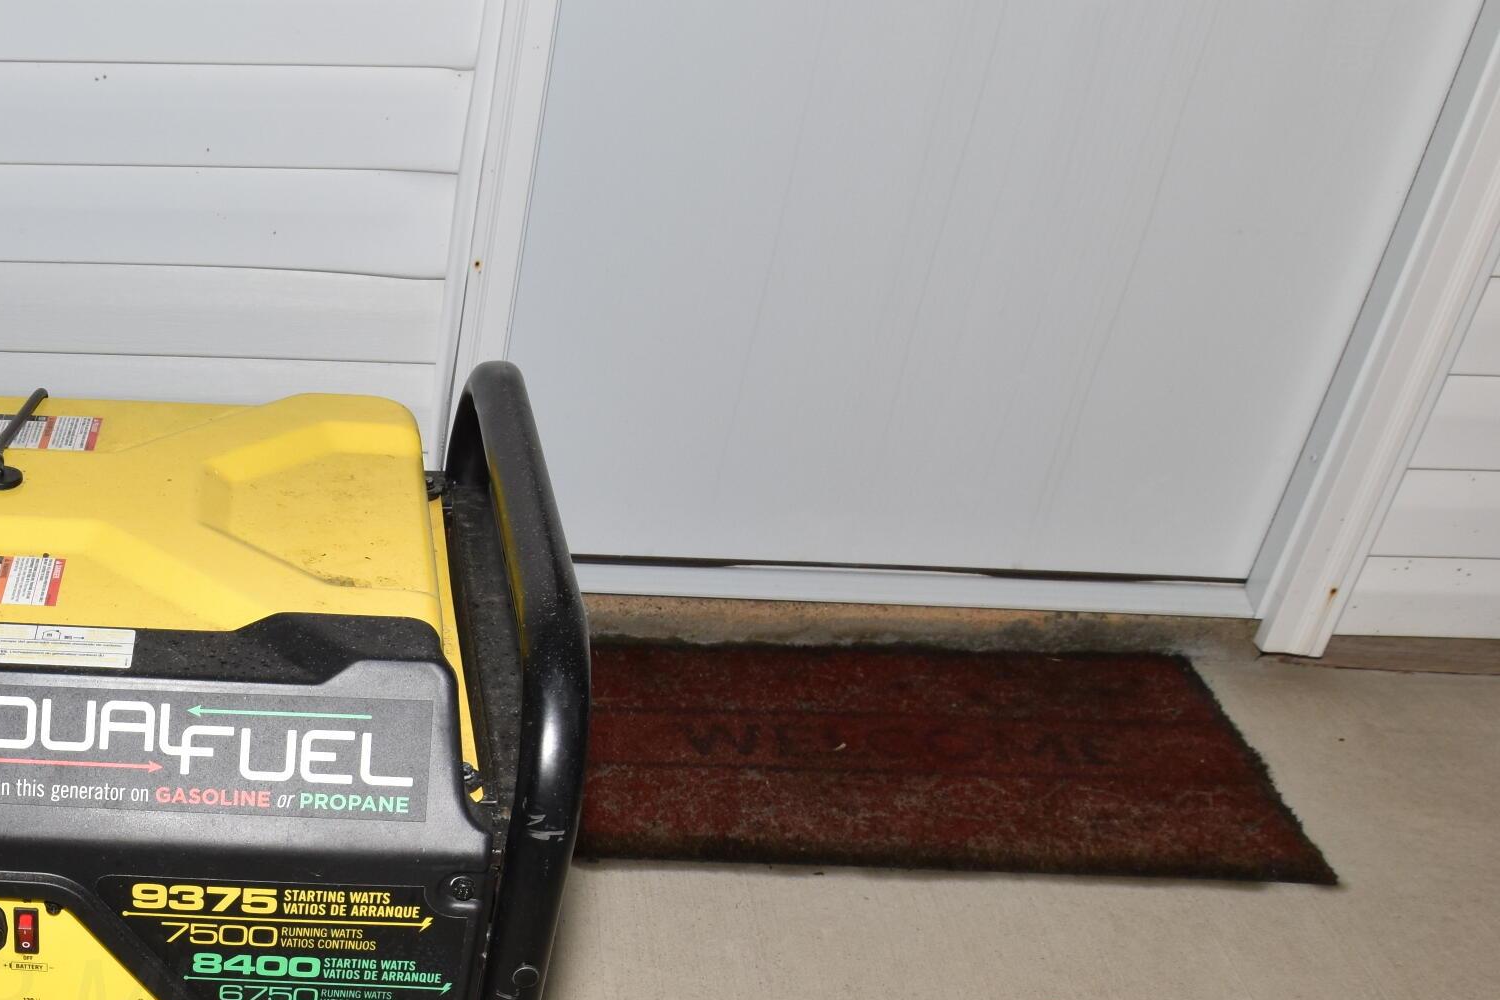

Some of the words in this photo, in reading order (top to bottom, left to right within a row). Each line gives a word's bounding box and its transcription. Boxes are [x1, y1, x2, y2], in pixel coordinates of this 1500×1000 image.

[678, 720, 1122, 766] WELCOME
[16, 777, 45, 798] this
[51, 780, 126, 803] generator
[131, 786, 149, 803] on
[155, 786, 271, 808] GASOLINE
[277, 793, 294, 809] or
[299, 793, 410, 814] PROPANE
[132, 883, 278, 914] 9375
[283, 889, 345, 904] STARTING
[350, 892, 391, 905] WATTS
[283, 903, 326, 916] VATIOS
[330, 905, 347, 917] DE
[350, 905, 421, 919] ARRANQUE
[161, 921, 278, 947] 7500
[281, 926, 327, 939] RUNNING
[330, 928, 364, 940] WATTS
[280, 938, 315, 949] VATIOS
[317, 939, 377, 951] CONTINUOS
[192, 952, 321, 978] 8400
[323, 957, 377, 970] STARTING
[380, 959, 416, 971] WATTS
[323, 969, 361, 980] VATIOS
[363, 970, 379, 981] DE
[381, 971, 442, 984] ARRANQUE
[321, 988, 360, 999] RUNNING
[363, 990, 392, 1000] WATTS
